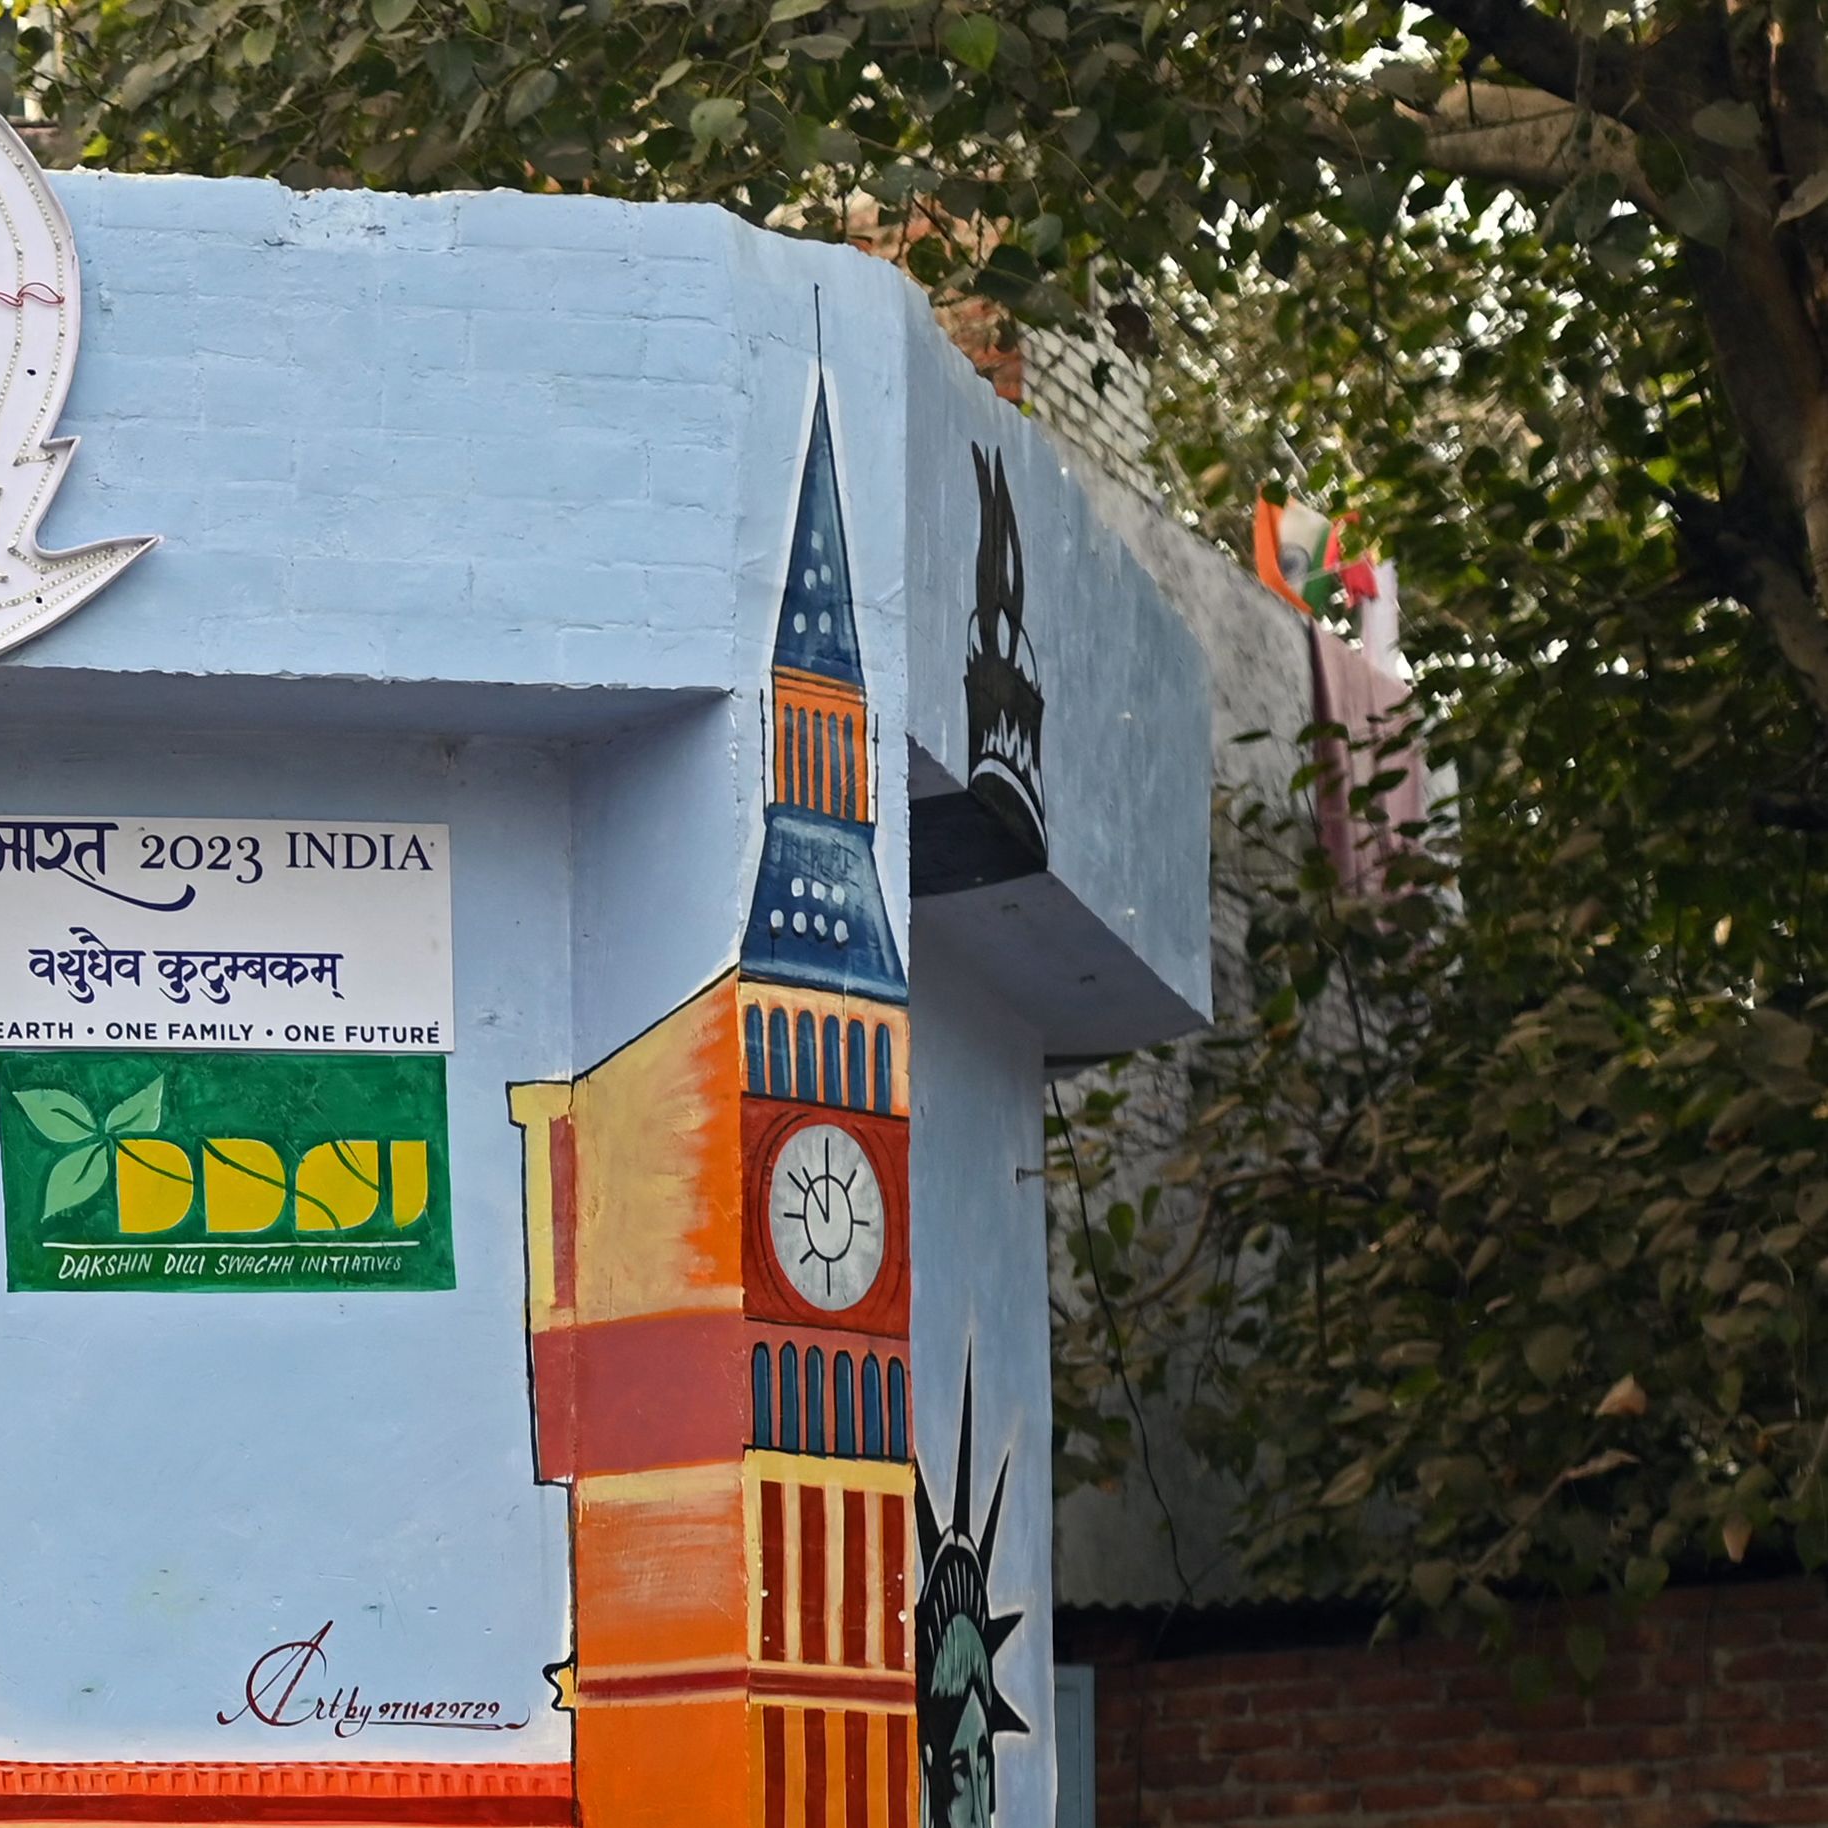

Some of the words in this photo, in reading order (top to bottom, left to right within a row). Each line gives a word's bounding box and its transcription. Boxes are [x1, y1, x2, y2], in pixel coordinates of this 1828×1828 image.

[139, 832, 263, 884] 2023
[285, 832, 433, 872] INDIA
[28, 927, 146, 1004] वसुधैव
[152, 950, 345, 1004] कुटुम्बकम्
[105, 1022, 158, 1040] ONE
[168, 1023, 254, 1042] FAMILY
[284, 1025, 335, 1043] ONE
[345, 1025, 440, 1045] FUTURE
[58, 1253, 153, 1281] DAKSHIN
[378, 1701, 501, 1721] 9711429729
